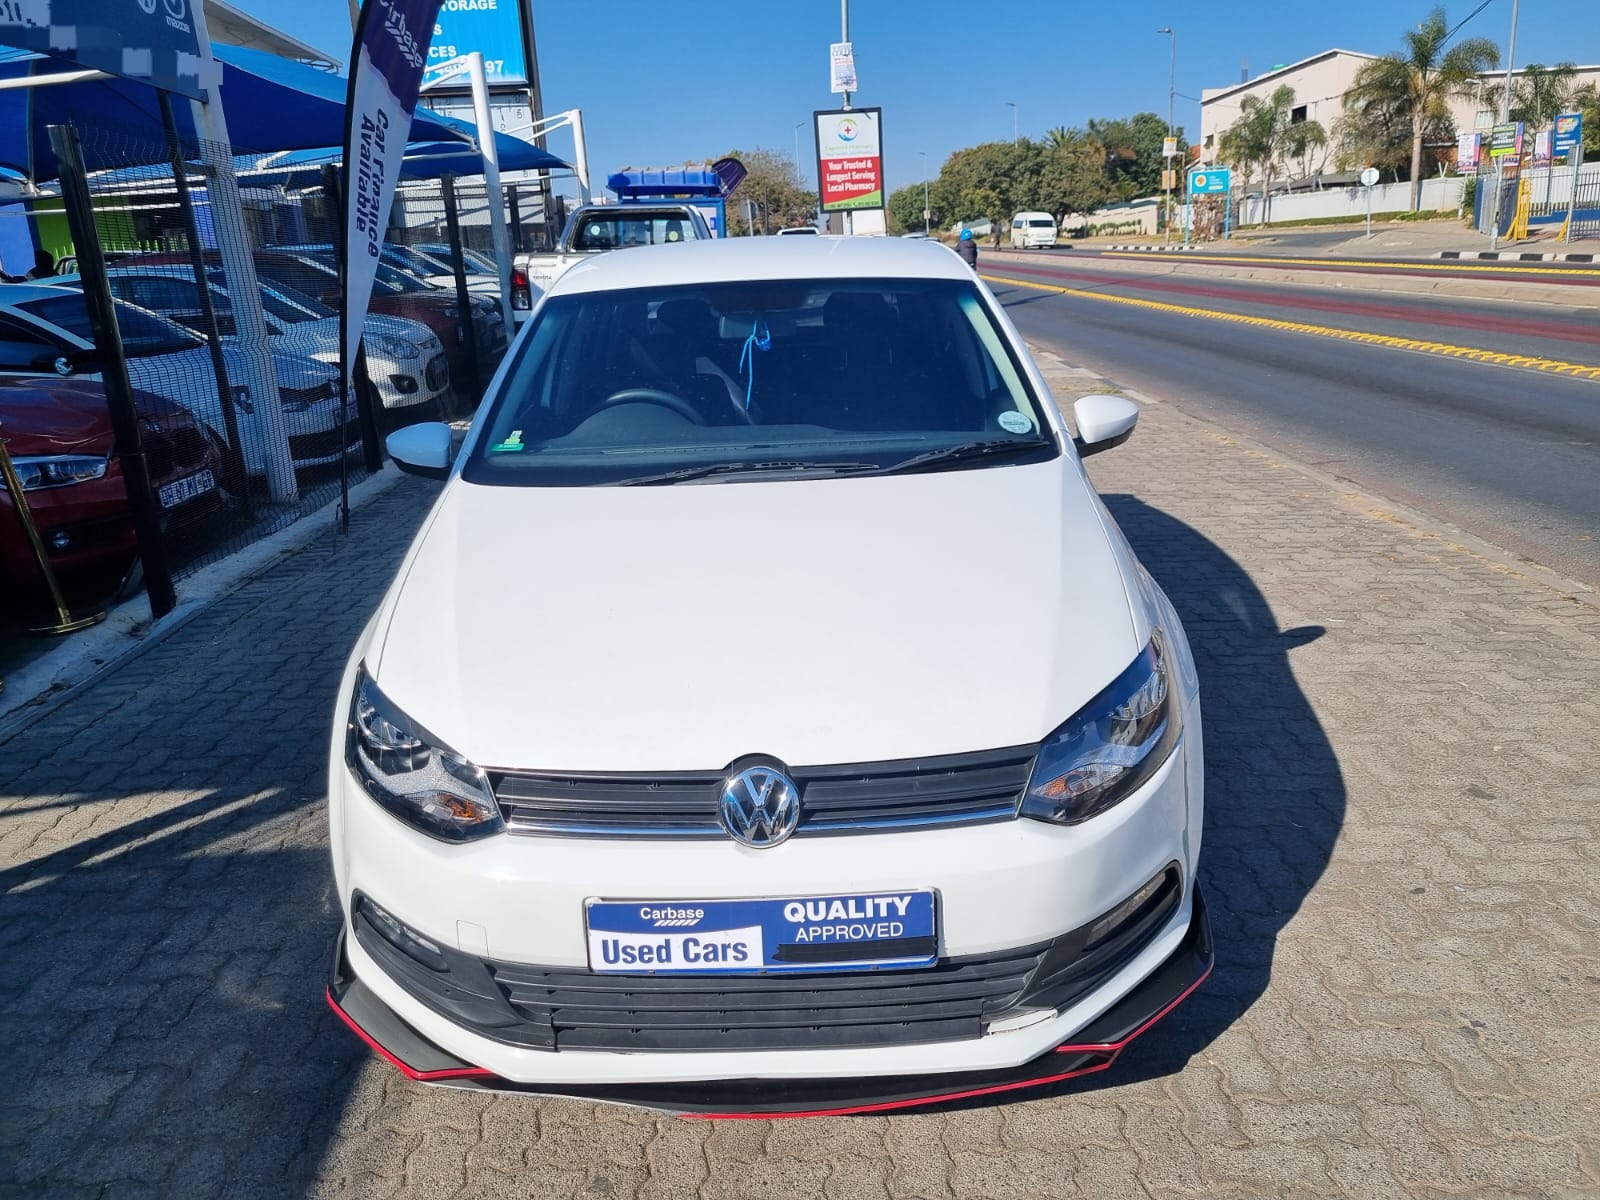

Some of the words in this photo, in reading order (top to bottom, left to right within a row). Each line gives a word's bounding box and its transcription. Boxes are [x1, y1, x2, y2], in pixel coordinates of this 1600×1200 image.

[374, 108, 389, 154] Car
[356, 112, 375, 233] Available
[826, 172, 851, 182] Longest
[852, 170, 875, 181] Serving
[828, 161, 843, 170] Your
[843, 160, 866, 170] Trusted
[827, 182, 845, 192] Local
[845, 182, 875, 192] Pharmacy
[368, 157, 384, 258] Finance
[640, 907, 704, 920] Carbase
[783, 895, 912, 924] QUALITY
[795, 922, 904, 942] APPROVED
[601, 938, 672, 965] Used
[682, 937, 749, 963] Cars
